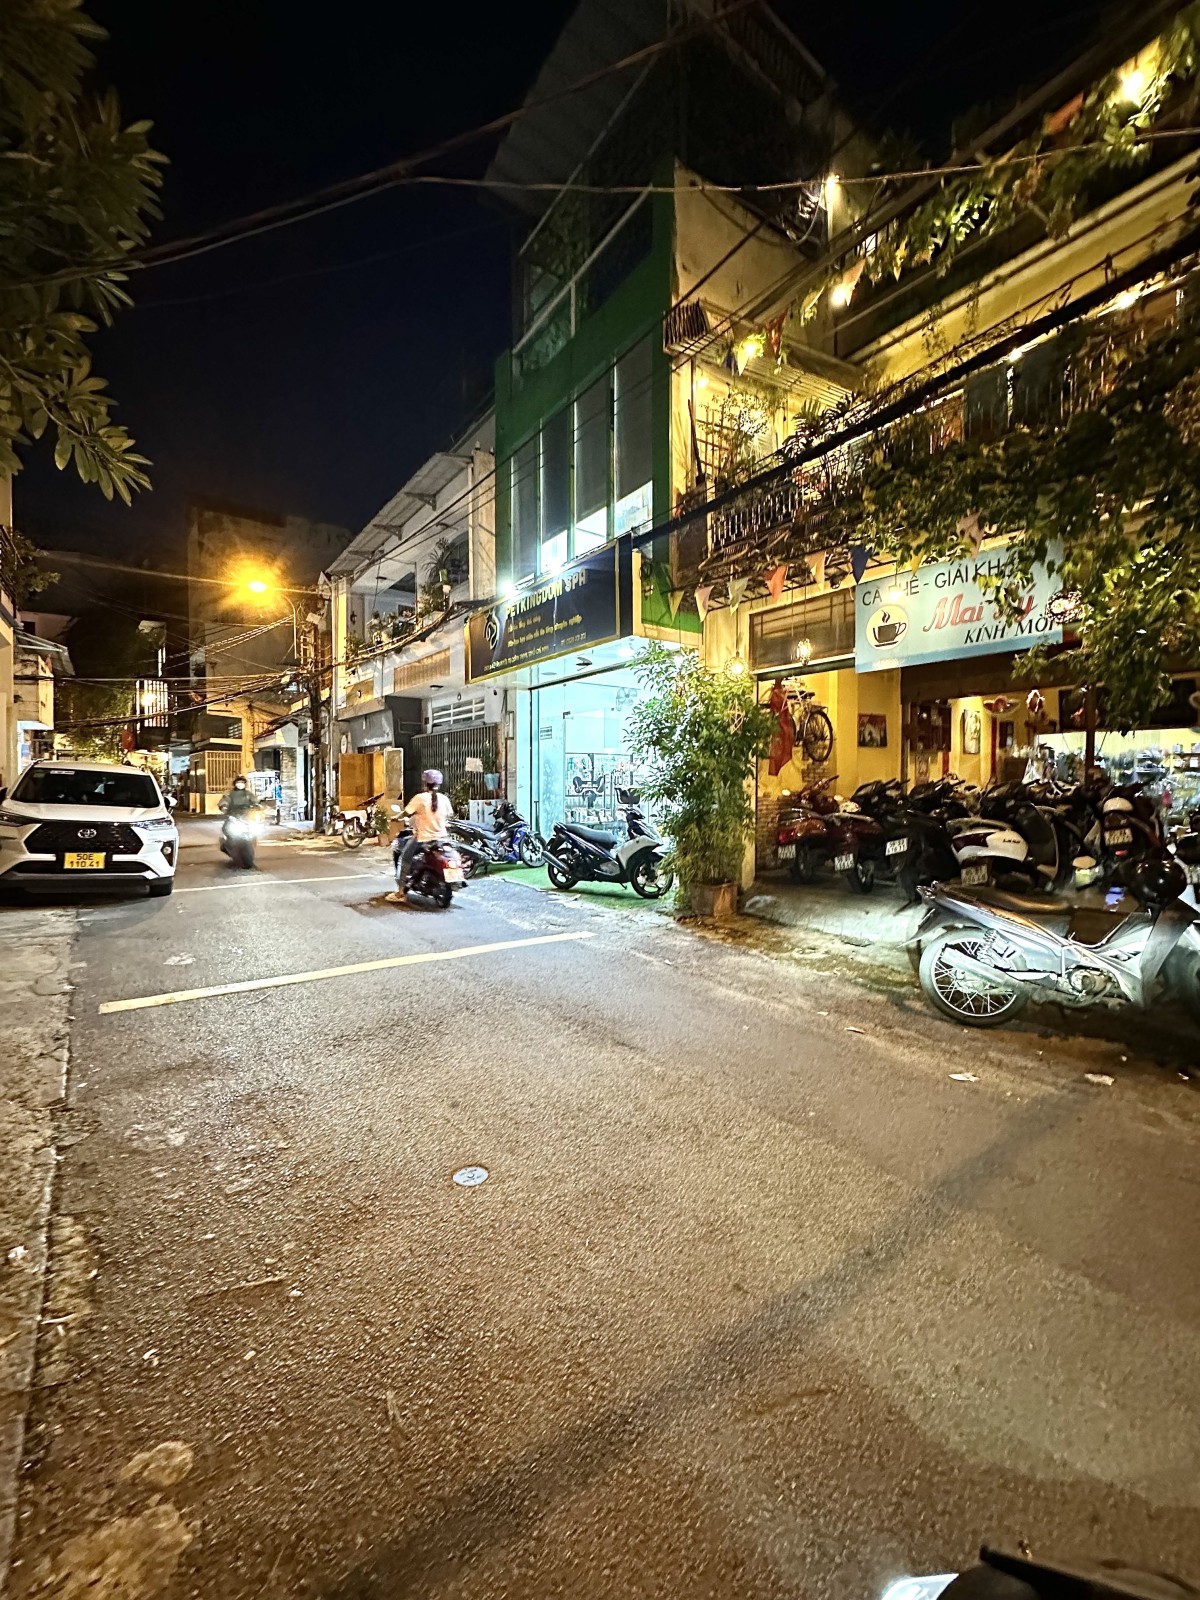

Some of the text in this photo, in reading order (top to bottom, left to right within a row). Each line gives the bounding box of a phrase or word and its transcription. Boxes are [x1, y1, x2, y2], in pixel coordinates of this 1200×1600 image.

[565, 569, 587, 592] SPA
[862, 585, 882, 606] CÀ
[922, 592, 984, 632] Mai
[963, 622, 1007, 644] KÍNH
[76, 853, 94, 861] 50E
